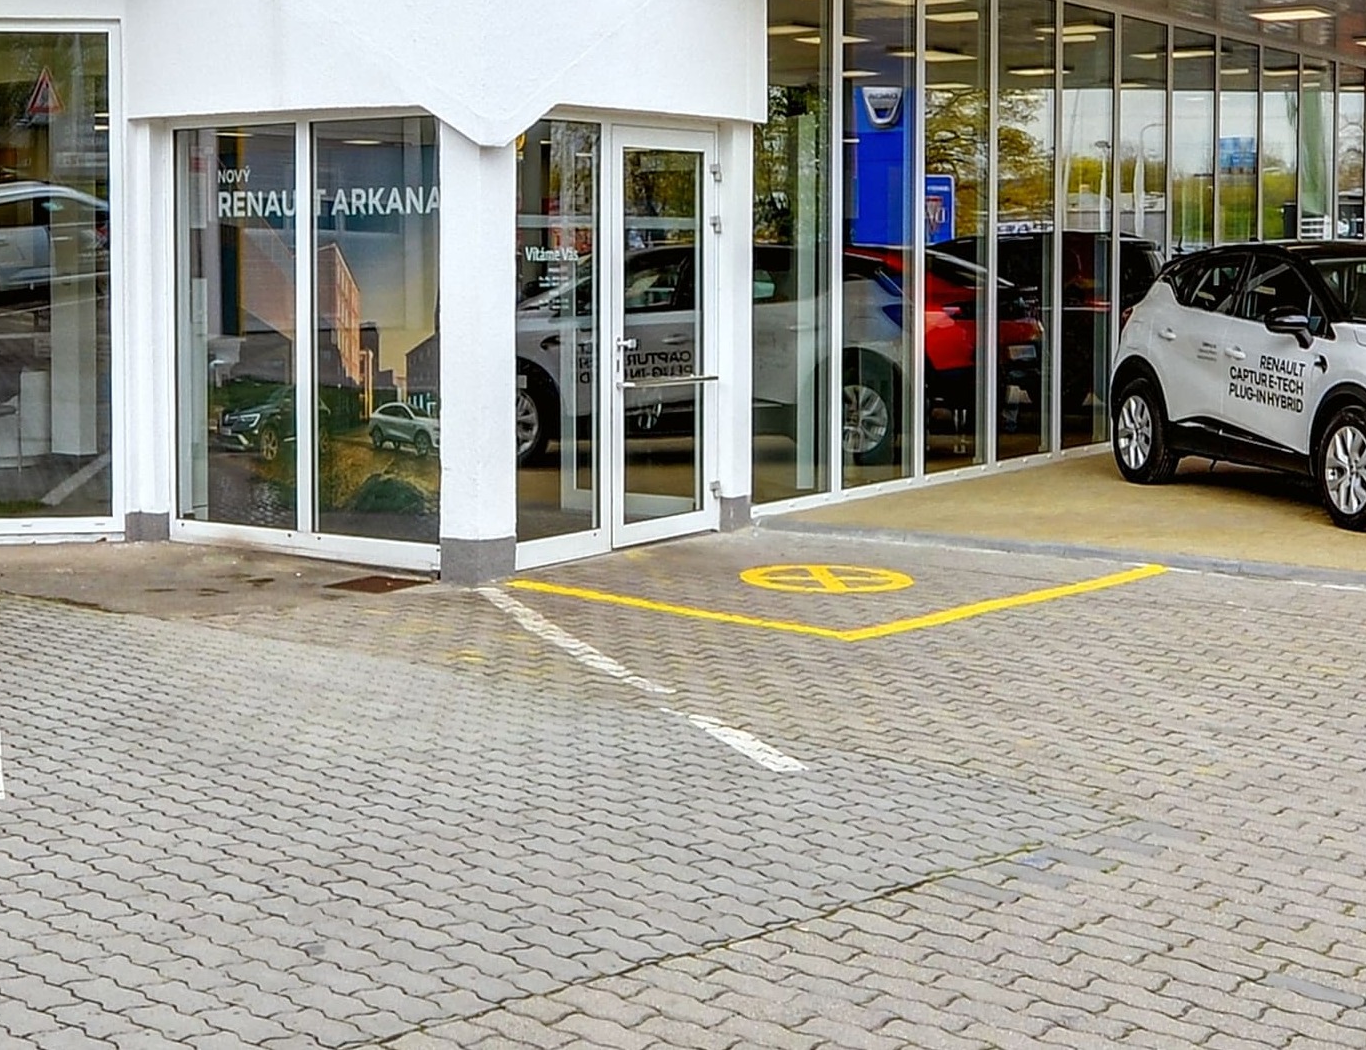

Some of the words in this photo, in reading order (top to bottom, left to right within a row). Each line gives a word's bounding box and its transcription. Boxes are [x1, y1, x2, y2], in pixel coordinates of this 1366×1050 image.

[217, 165, 251, 184] NOVÝ
[217, 189, 327, 218] RENAUT
[331, 185, 440, 217] ARKANA
[1229, 366, 1268, 388] CAPTUR
[1268, 373, 1304, 396] E-TECH
[1260, 355, 1306, 378] RENAULT
[1229, 382, 1267, 404] PLUG-IN
[1267, 392, 1304, 413] HYBRID
